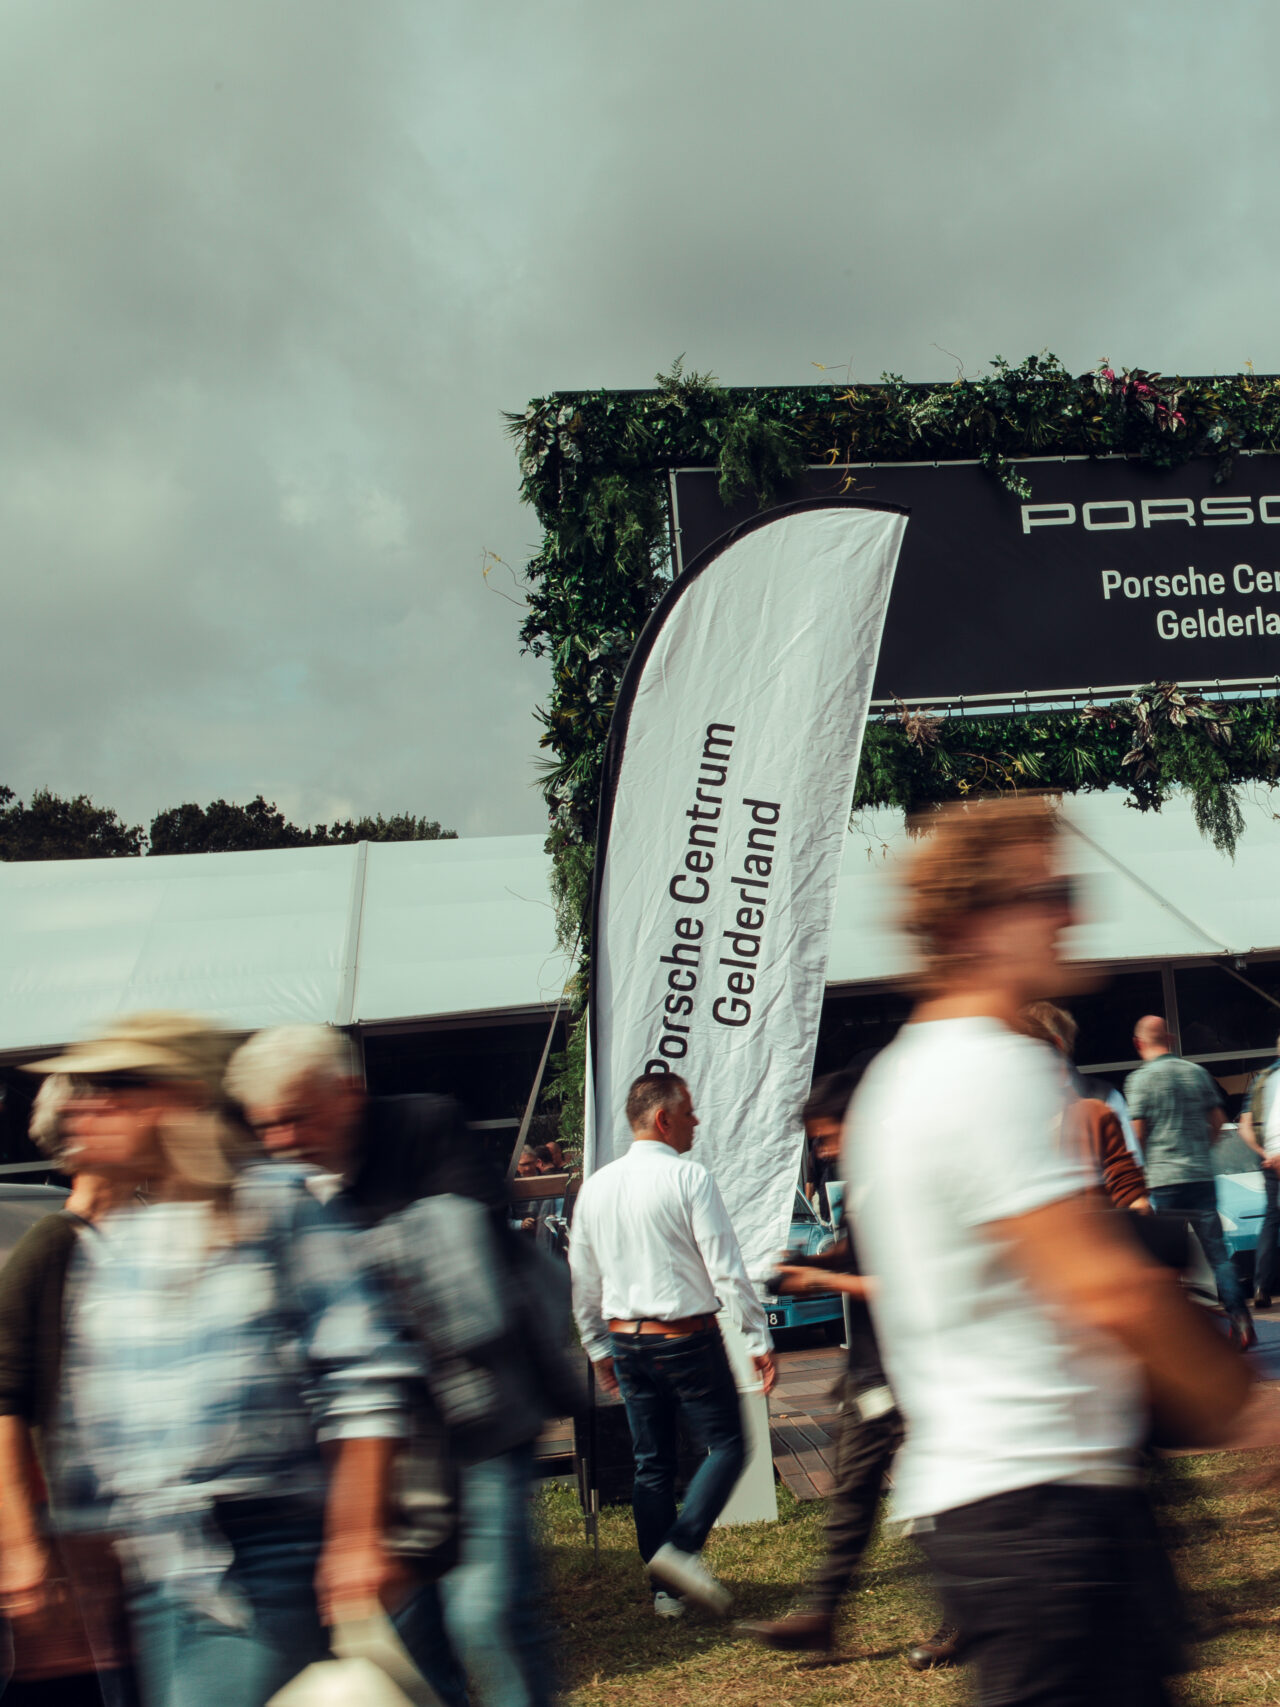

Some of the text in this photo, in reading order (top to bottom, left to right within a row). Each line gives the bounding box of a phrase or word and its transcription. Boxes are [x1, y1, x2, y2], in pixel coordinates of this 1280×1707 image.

[1101, 566, 1226, 600] Porsche
[669, 722, 736, 904] Centrum
[712, 797, 781, 1027] Gelderland
